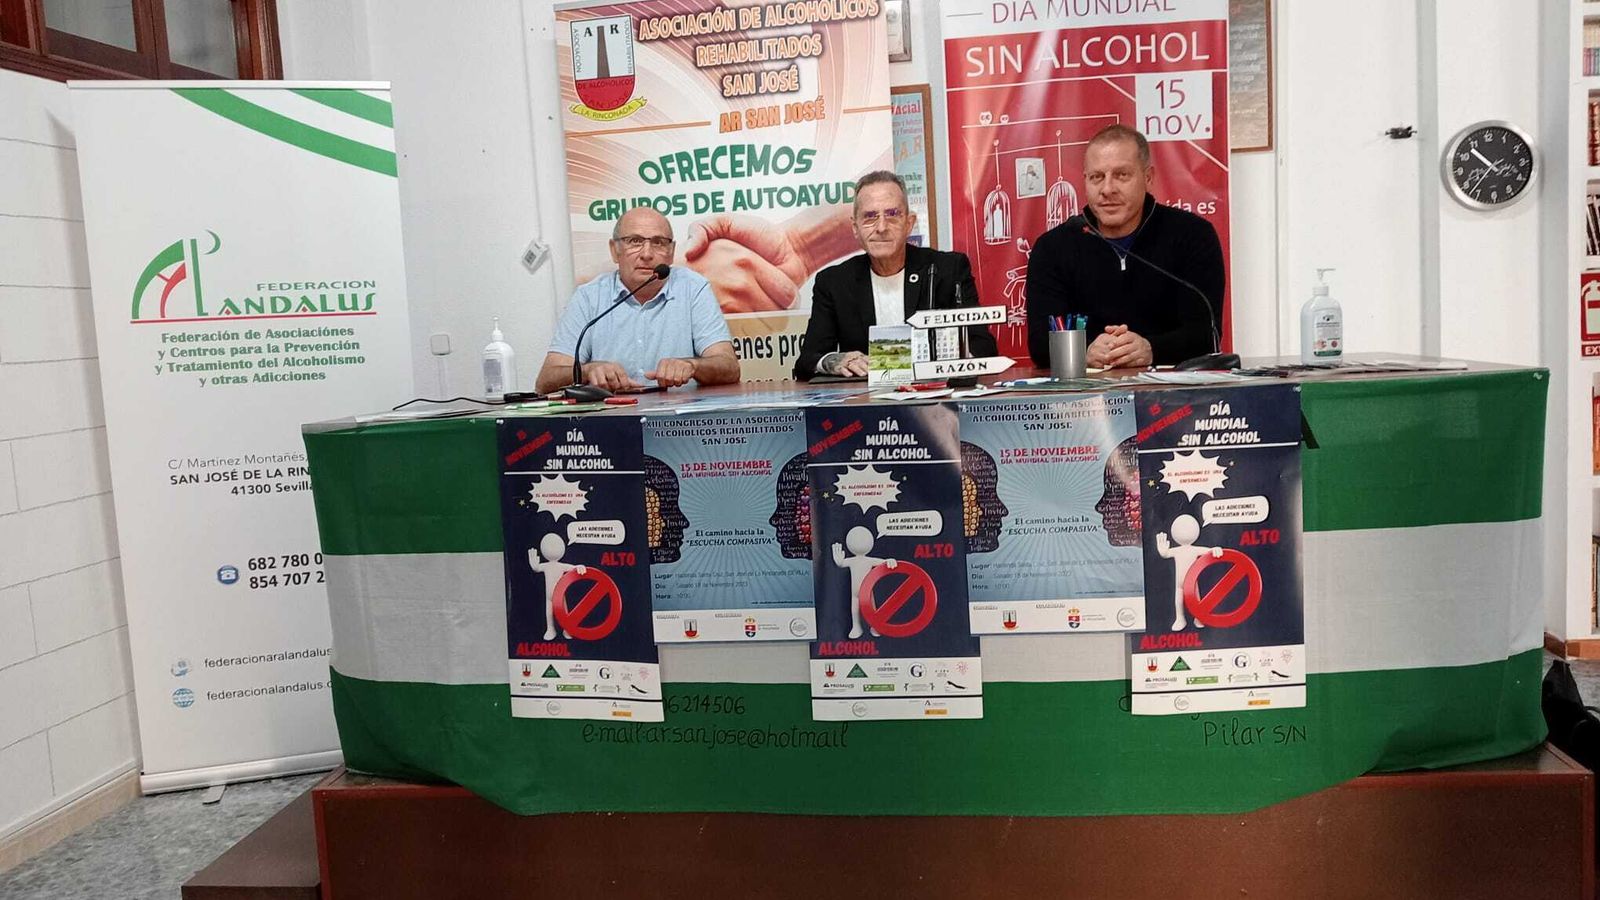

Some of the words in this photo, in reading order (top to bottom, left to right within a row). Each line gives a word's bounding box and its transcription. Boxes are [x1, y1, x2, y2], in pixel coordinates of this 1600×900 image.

[638, 6, 736, 40] ASOCIACIÓN
[739, 5, 761, 29] DE
[584, 27, 593, 37] A
[610, 24, 620, 35] R
[696, 33, 822, 67] REHABILITADOS
[966, 44, 1022, 77] SIN
[1034, 31, 1210, 71] ALCOHOL
[723, 73, 755, 97] SAN
[759, 66, 799, 93] JOSÉ
[1155, 79, 1184, 109] 15
[719, 111, 742, 133] AR
[745, 107, 780, 130] SAN
[784, 96, 825, 124] JOSÉ
[1146, 114, 1211, 136] nov.
[1484, 132, 1493, 142] 12
[1460, 152, 1470, 161] 10
[638, 143, 817, 185] OFRECEMOS
[693, 191, 726, 214] DE
[1197, 201, 1216, 215] es
[257, 281, 376, 291] FEDERACION
[218, 292, 376, 315] ANDALUS
[923, 311, 1001, 325] FELICIDAD
[161, 330, 240, 344] Federación
[244, 329, 261, 341] de
[158, 349, 165, 360] y
[170, 347, 225, 359] Centros
[230, 345, 262, 357] para
[266, 342, 280, 354] la
[284, 340, 360, 354] Prevención
[155, 364, 163, 375] y
[167, 360, 253, 373] Tratamiento
[257, 357, 279, 369] del
[283, 354, 365, 368] Alcoholismo
[935, 361, 988, 374] RAZÓN
[199, 376, 207, 387] y
[211, 373, 248, 385] otras
[252, 370, 326, 383] Adicciones
[983, 403, 1037, 412] CONGRESO
[1209, 400, 1231, 416] DÍA
[664, 418, 713, 427] CONGRESO
[716, 418, 727, 426] DE
[878, 416, 899, 432] DÍA
[973, 413, 1041, 423] ALCOHOLICOS
[1195, 417, 1249, 431] MUNDIAL
[654, 428, 717, 437] ALCOHOLICOS
[720, 425, 794, 435] REHABILITADOS
[1023, 423, 1045, 431] SAN
[566, 428, 584, 442] DÍA
[866, 434, 918, 446] MUNDIAL
[1204, 431, 1261, 445] ALCOHOL
[556, 445, 602, 456] MUNDIAL
[877, 447, 931, 460] ALCOHOL
[1000, 449, 1011, 458] 15
[1013, 448, 1028, 457] DE
[1031, 445, 1100, 456] NOVIEMBRE
[168, 459, 182, 470] C/
[567, 459, 614, 470] ALCOHOL
[680, 463, 691, 471] 15
[693, 462, 707, 471] DE
[709, 460, 772, 470] NOVIEMBRE
[170, 474, 199, 485] SAN
[204, 468, 239, 483] JOSÉ
[243, 470, 261, 480] DE
[266, 469, 283, 478] LA
[231, 484, 271, 495] 41300
[1025, 517, 1055, 525] camino
[1057, 515, 1079, 524] hacia
[1081, 515, 1089, 523] la
[735, 528, 755, 536] hacia
[1239, 528, 1280, 546] ALTO
[914, 543, 954, 559] ALTO
[248, 557, 276, 570] 682
[281, 554, 309, 568] 780
[601, 552, 636, 566] ALTO
[249, 576, 278, 589] 854
[283, 572, 310, 586] 707
[1141, 632, 1203, 649] ALCOHOL
[516, 642, 571, 656] ALCOHOL
[819, 641, 879, 657] ALCOHOL
[1204, 718, 1265, 745] Pilar
